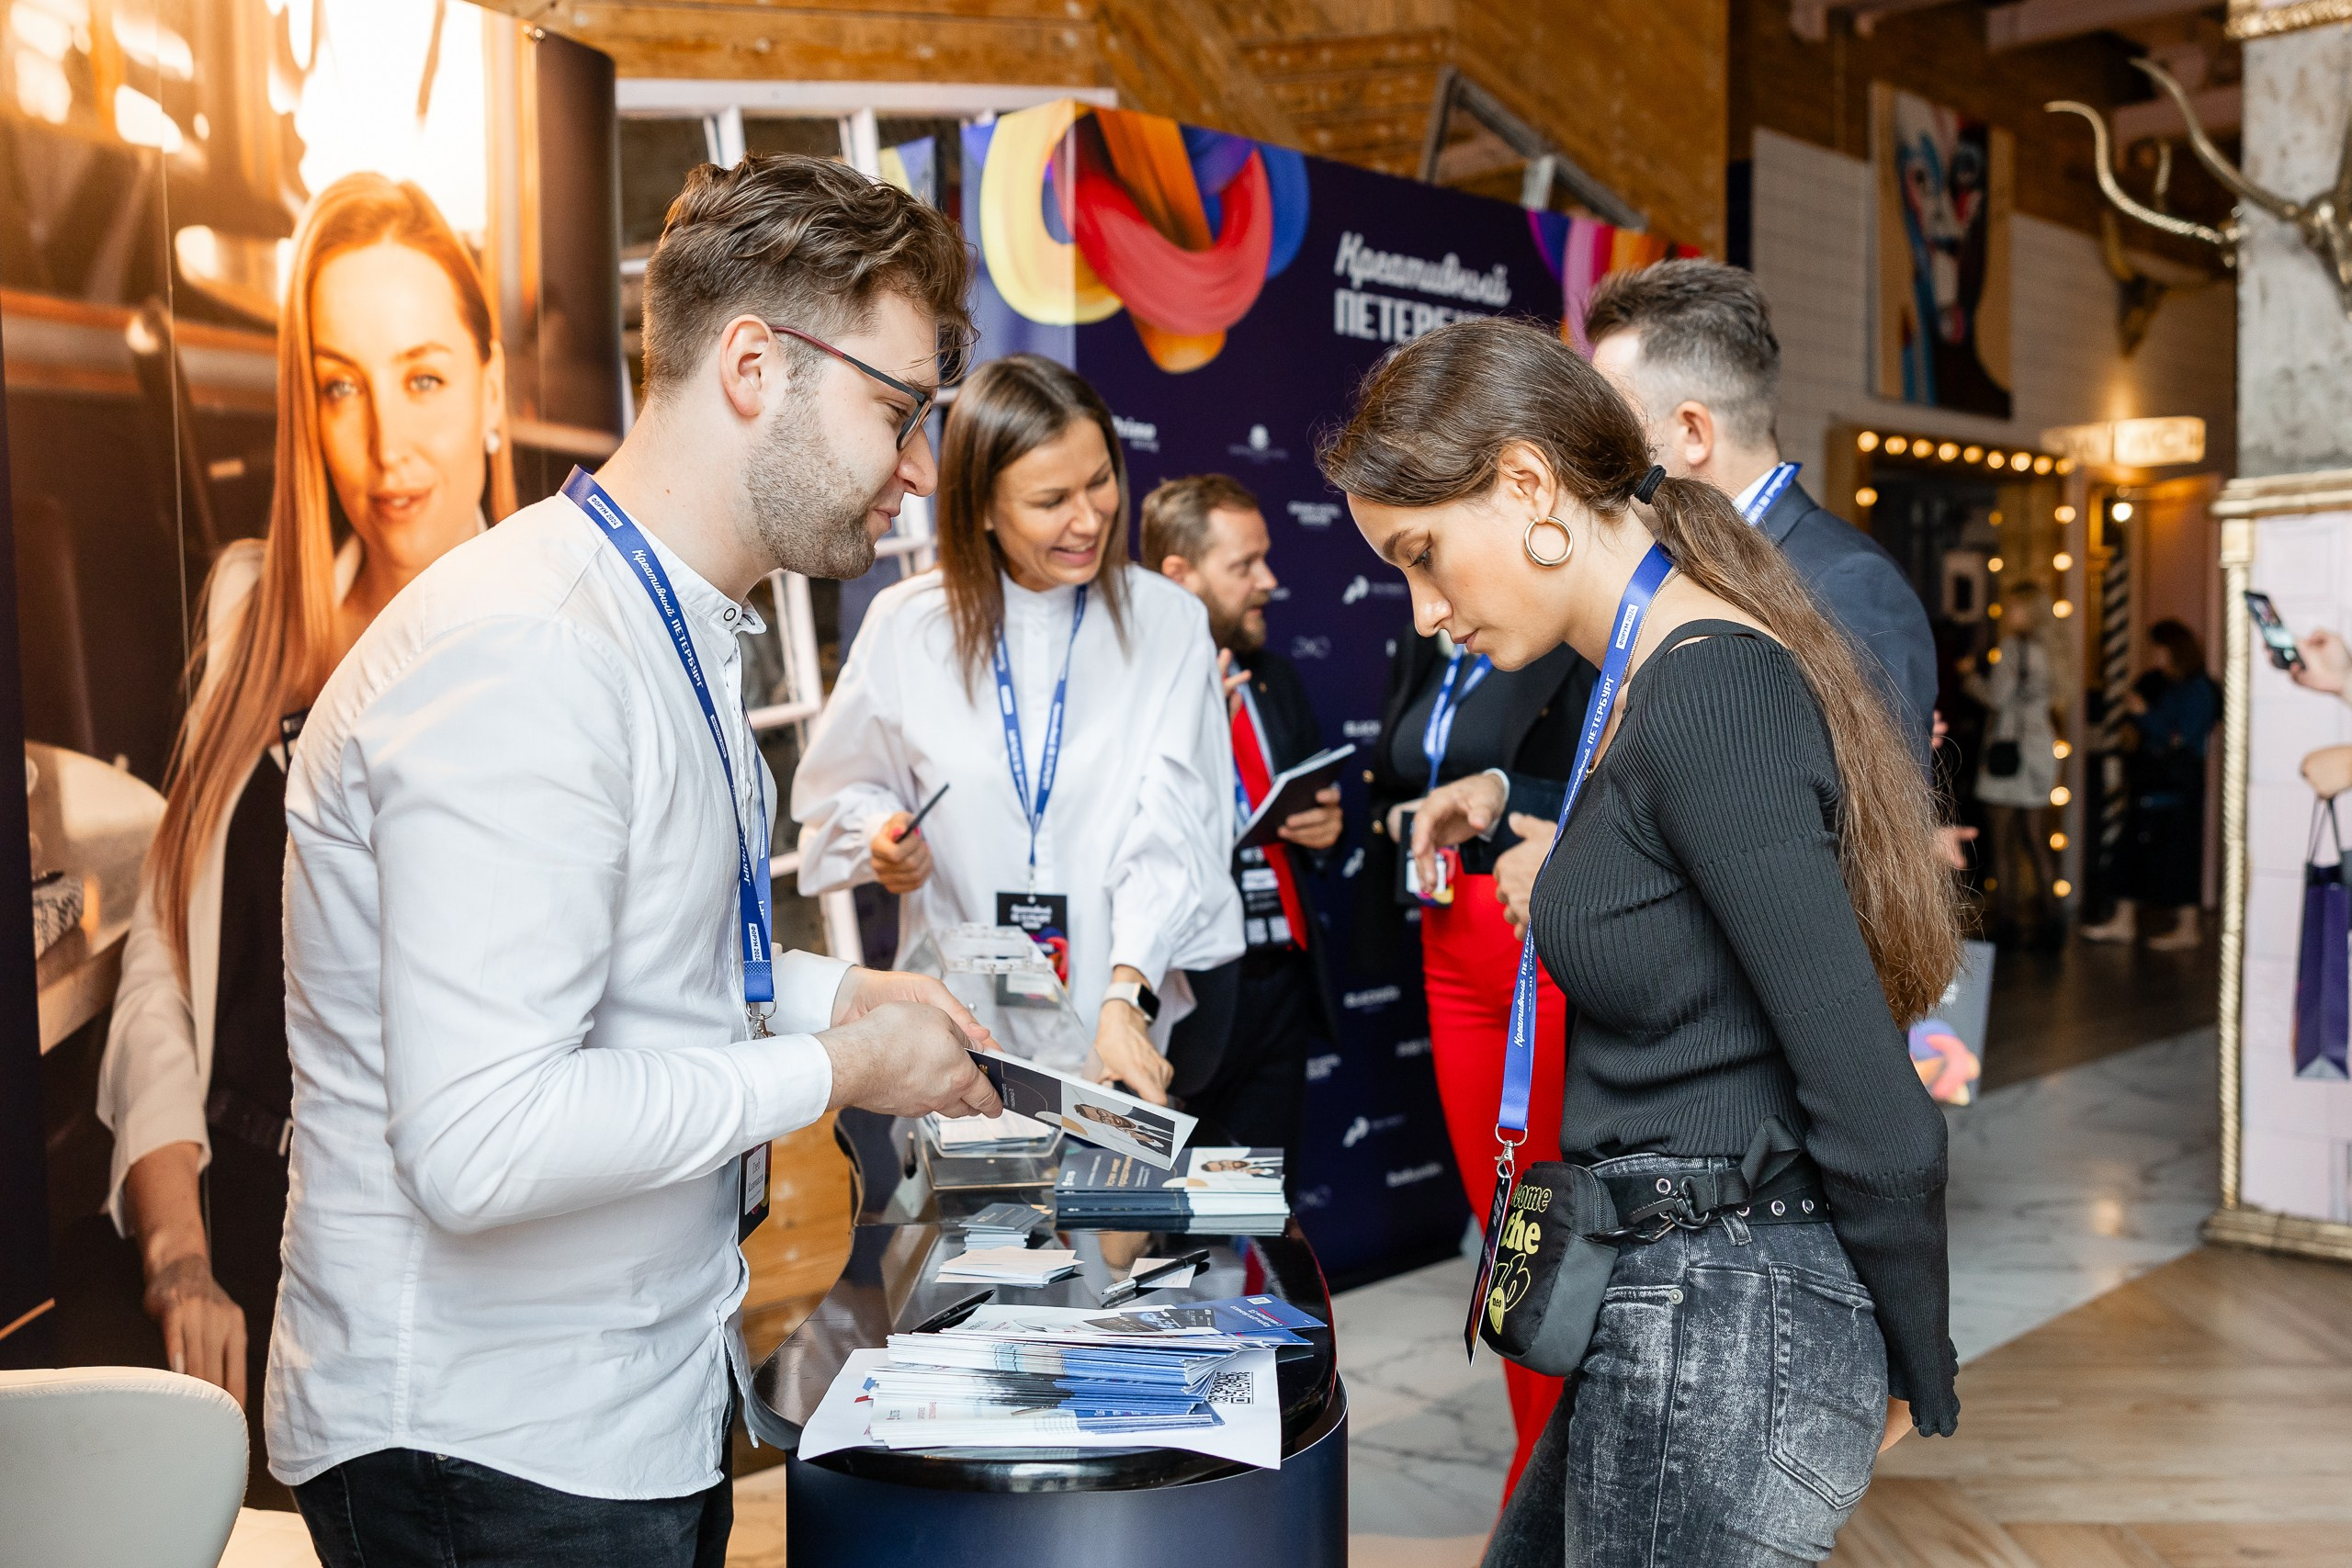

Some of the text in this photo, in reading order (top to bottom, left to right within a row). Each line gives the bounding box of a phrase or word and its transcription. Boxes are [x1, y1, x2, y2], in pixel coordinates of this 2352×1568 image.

[1334, 231, 1512, 308] Креативный
[591, 497, 620, 526] ФОРУМ 2024
[632, 548, 704, 688] Креативный ПЕТЕРБУРГ
[1619, 607, 1635, 646] ФОРУМ 2024
[1587, 673, 1614, 744] ПЕТЕРБУРГ
[751, 926, 760, 948] ФОРУМ
[1514, 978, 1526, 1047] Креативный
[1500, 1210, 1541, 1254] the
